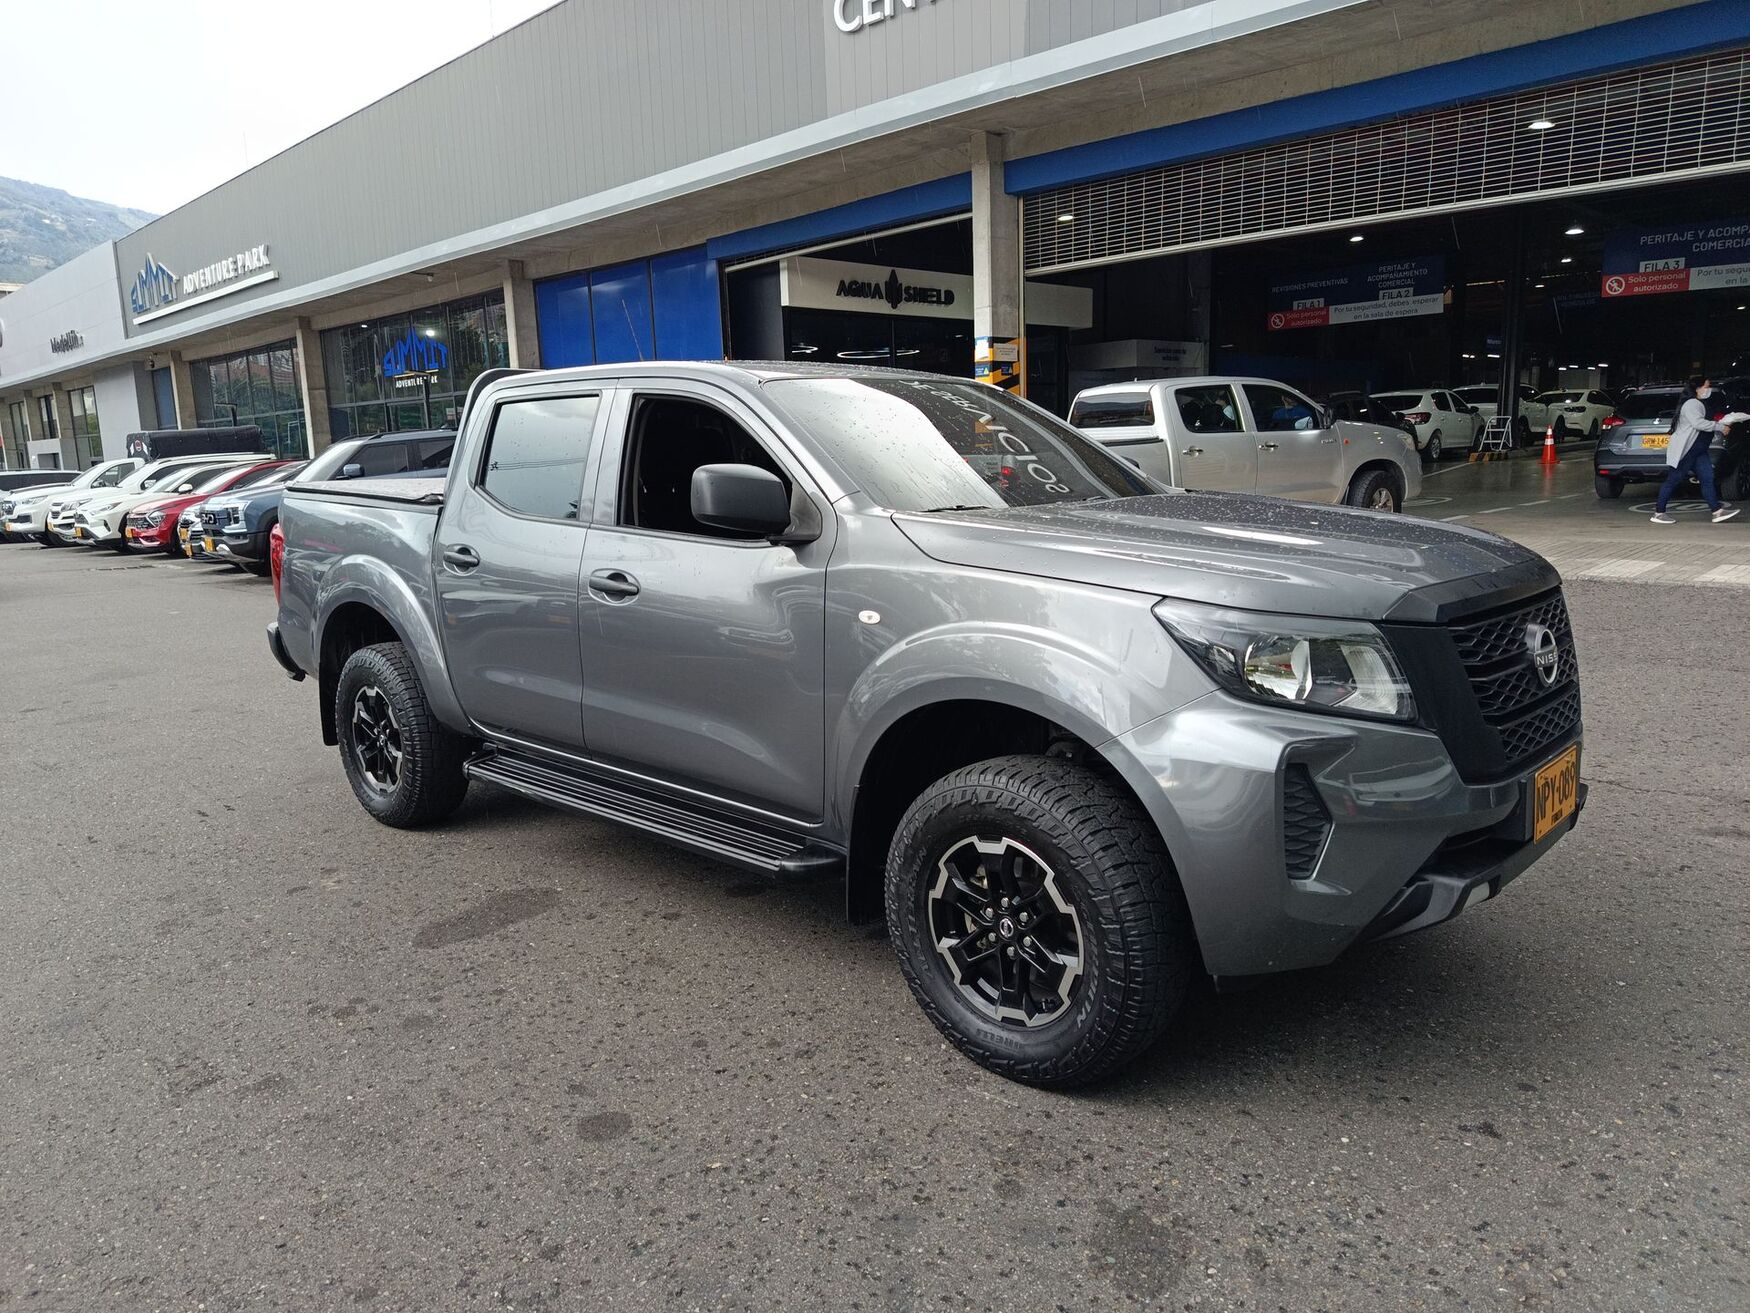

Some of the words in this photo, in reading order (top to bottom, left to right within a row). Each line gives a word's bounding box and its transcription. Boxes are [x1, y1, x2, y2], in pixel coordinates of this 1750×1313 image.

[1640, 231, 1695, 246] PERITAJE
[1698, 230, 1706, 240] Y
[183, 257, 236, 295] ADVENTURE
[237, 244, 271, 274] PARK
[1378, 262, 1411, 273] PERITAJE
[1644, 261, 1671, 273] FILA
[1673, 260, 1680, 270] 3
[1725, 268, 1750, 277] segu
[131, 252, 179, 313] SUMMIT
[1378, 278, 1415, 288] COMERCIAL
[1627, 275, 1645, 284] Solo
[1648, 271, 1686, 283] personal
[1725, 278, 1737, 286] en
[1739, 276, 1748, 285] la
[836, 279, 884, 299] AGUA
[904, 285, 955, 306] SHIELD
[1633, 282, 1679, 292] autorizado
[1382, 290, 1403, 300] FILA
[1404, 289, 1410, 298] 2
[384, 325, 448, 378] SUMMIT
[395, 377, 423, 388] ADVENTURE
[1536, 761, 1576, 825] NPY-089
